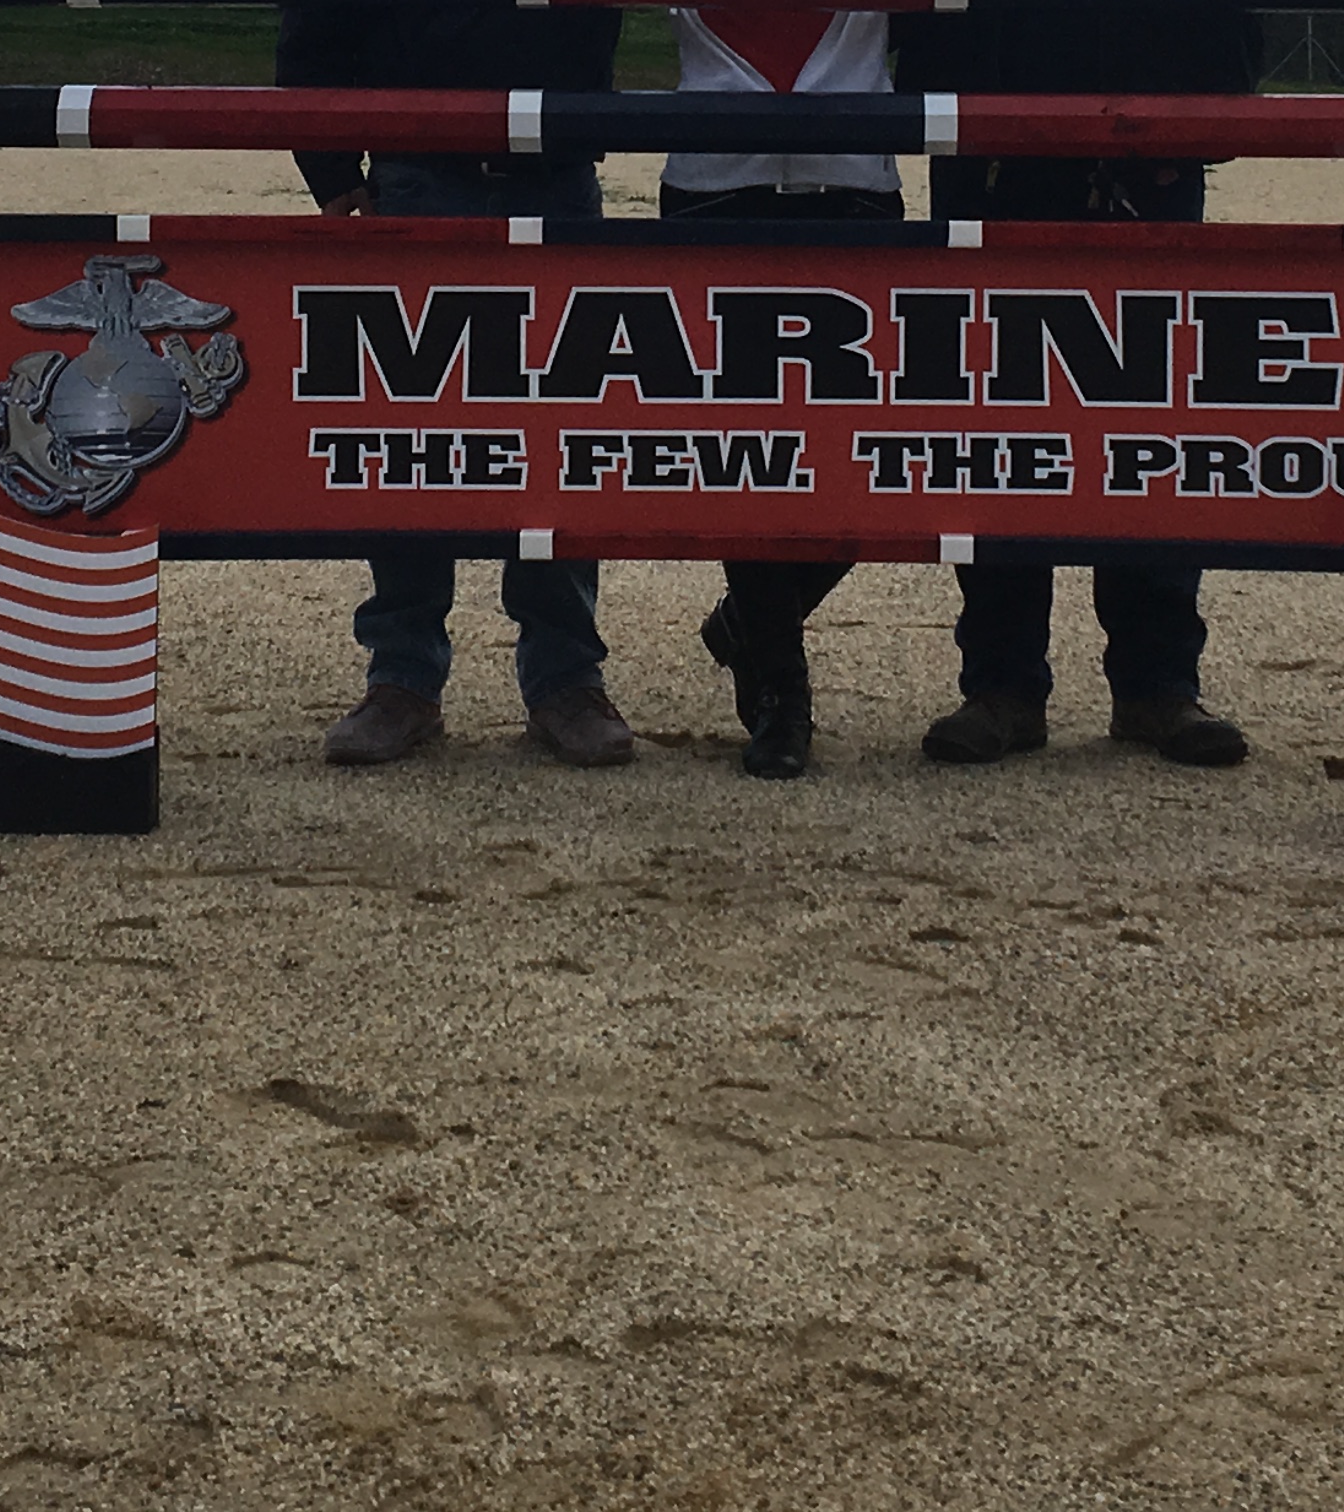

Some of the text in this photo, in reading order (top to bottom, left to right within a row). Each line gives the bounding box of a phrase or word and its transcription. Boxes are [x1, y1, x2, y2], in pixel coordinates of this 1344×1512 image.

[307, 427, 529, 491] THE
[558, 428, 815, 494] FEW.
[851, 430, 1075, 496] THE
